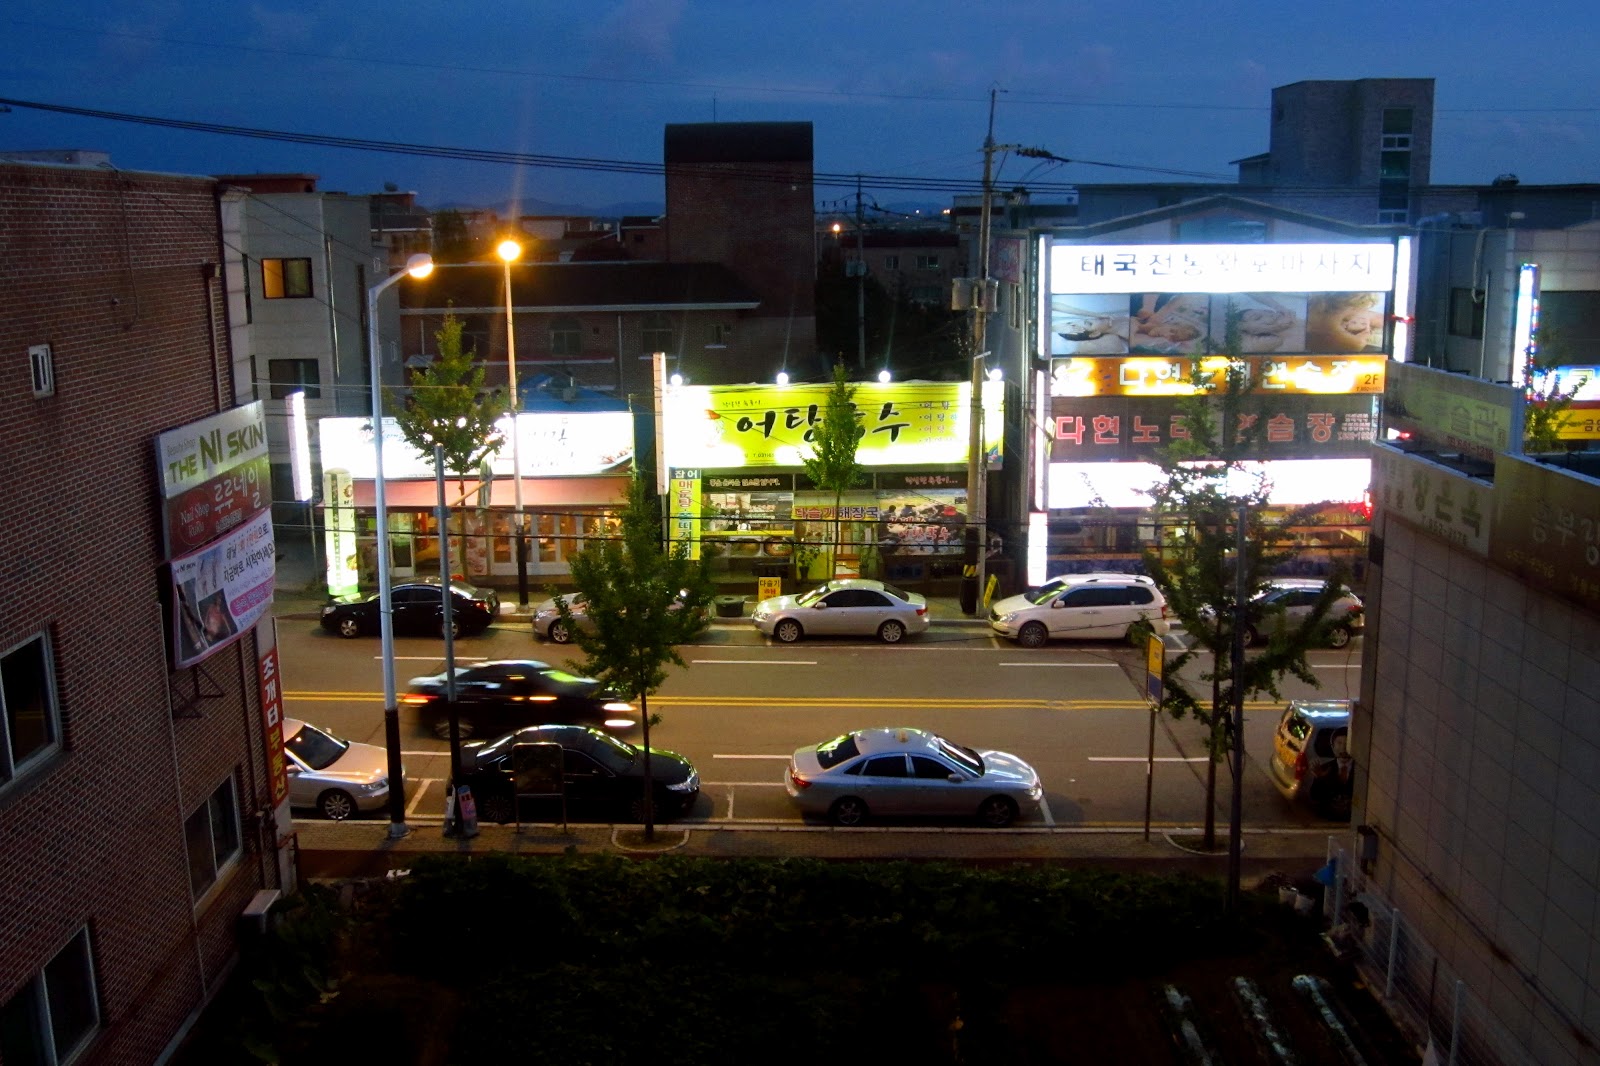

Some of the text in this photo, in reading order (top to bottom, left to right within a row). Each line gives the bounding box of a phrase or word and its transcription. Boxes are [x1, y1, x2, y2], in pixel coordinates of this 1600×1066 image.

[1364, 374, 1380, 386] 2F
[736, 402, 911, 444] 어탕수
[169, 421, 264, 483] THE NI SKIN
